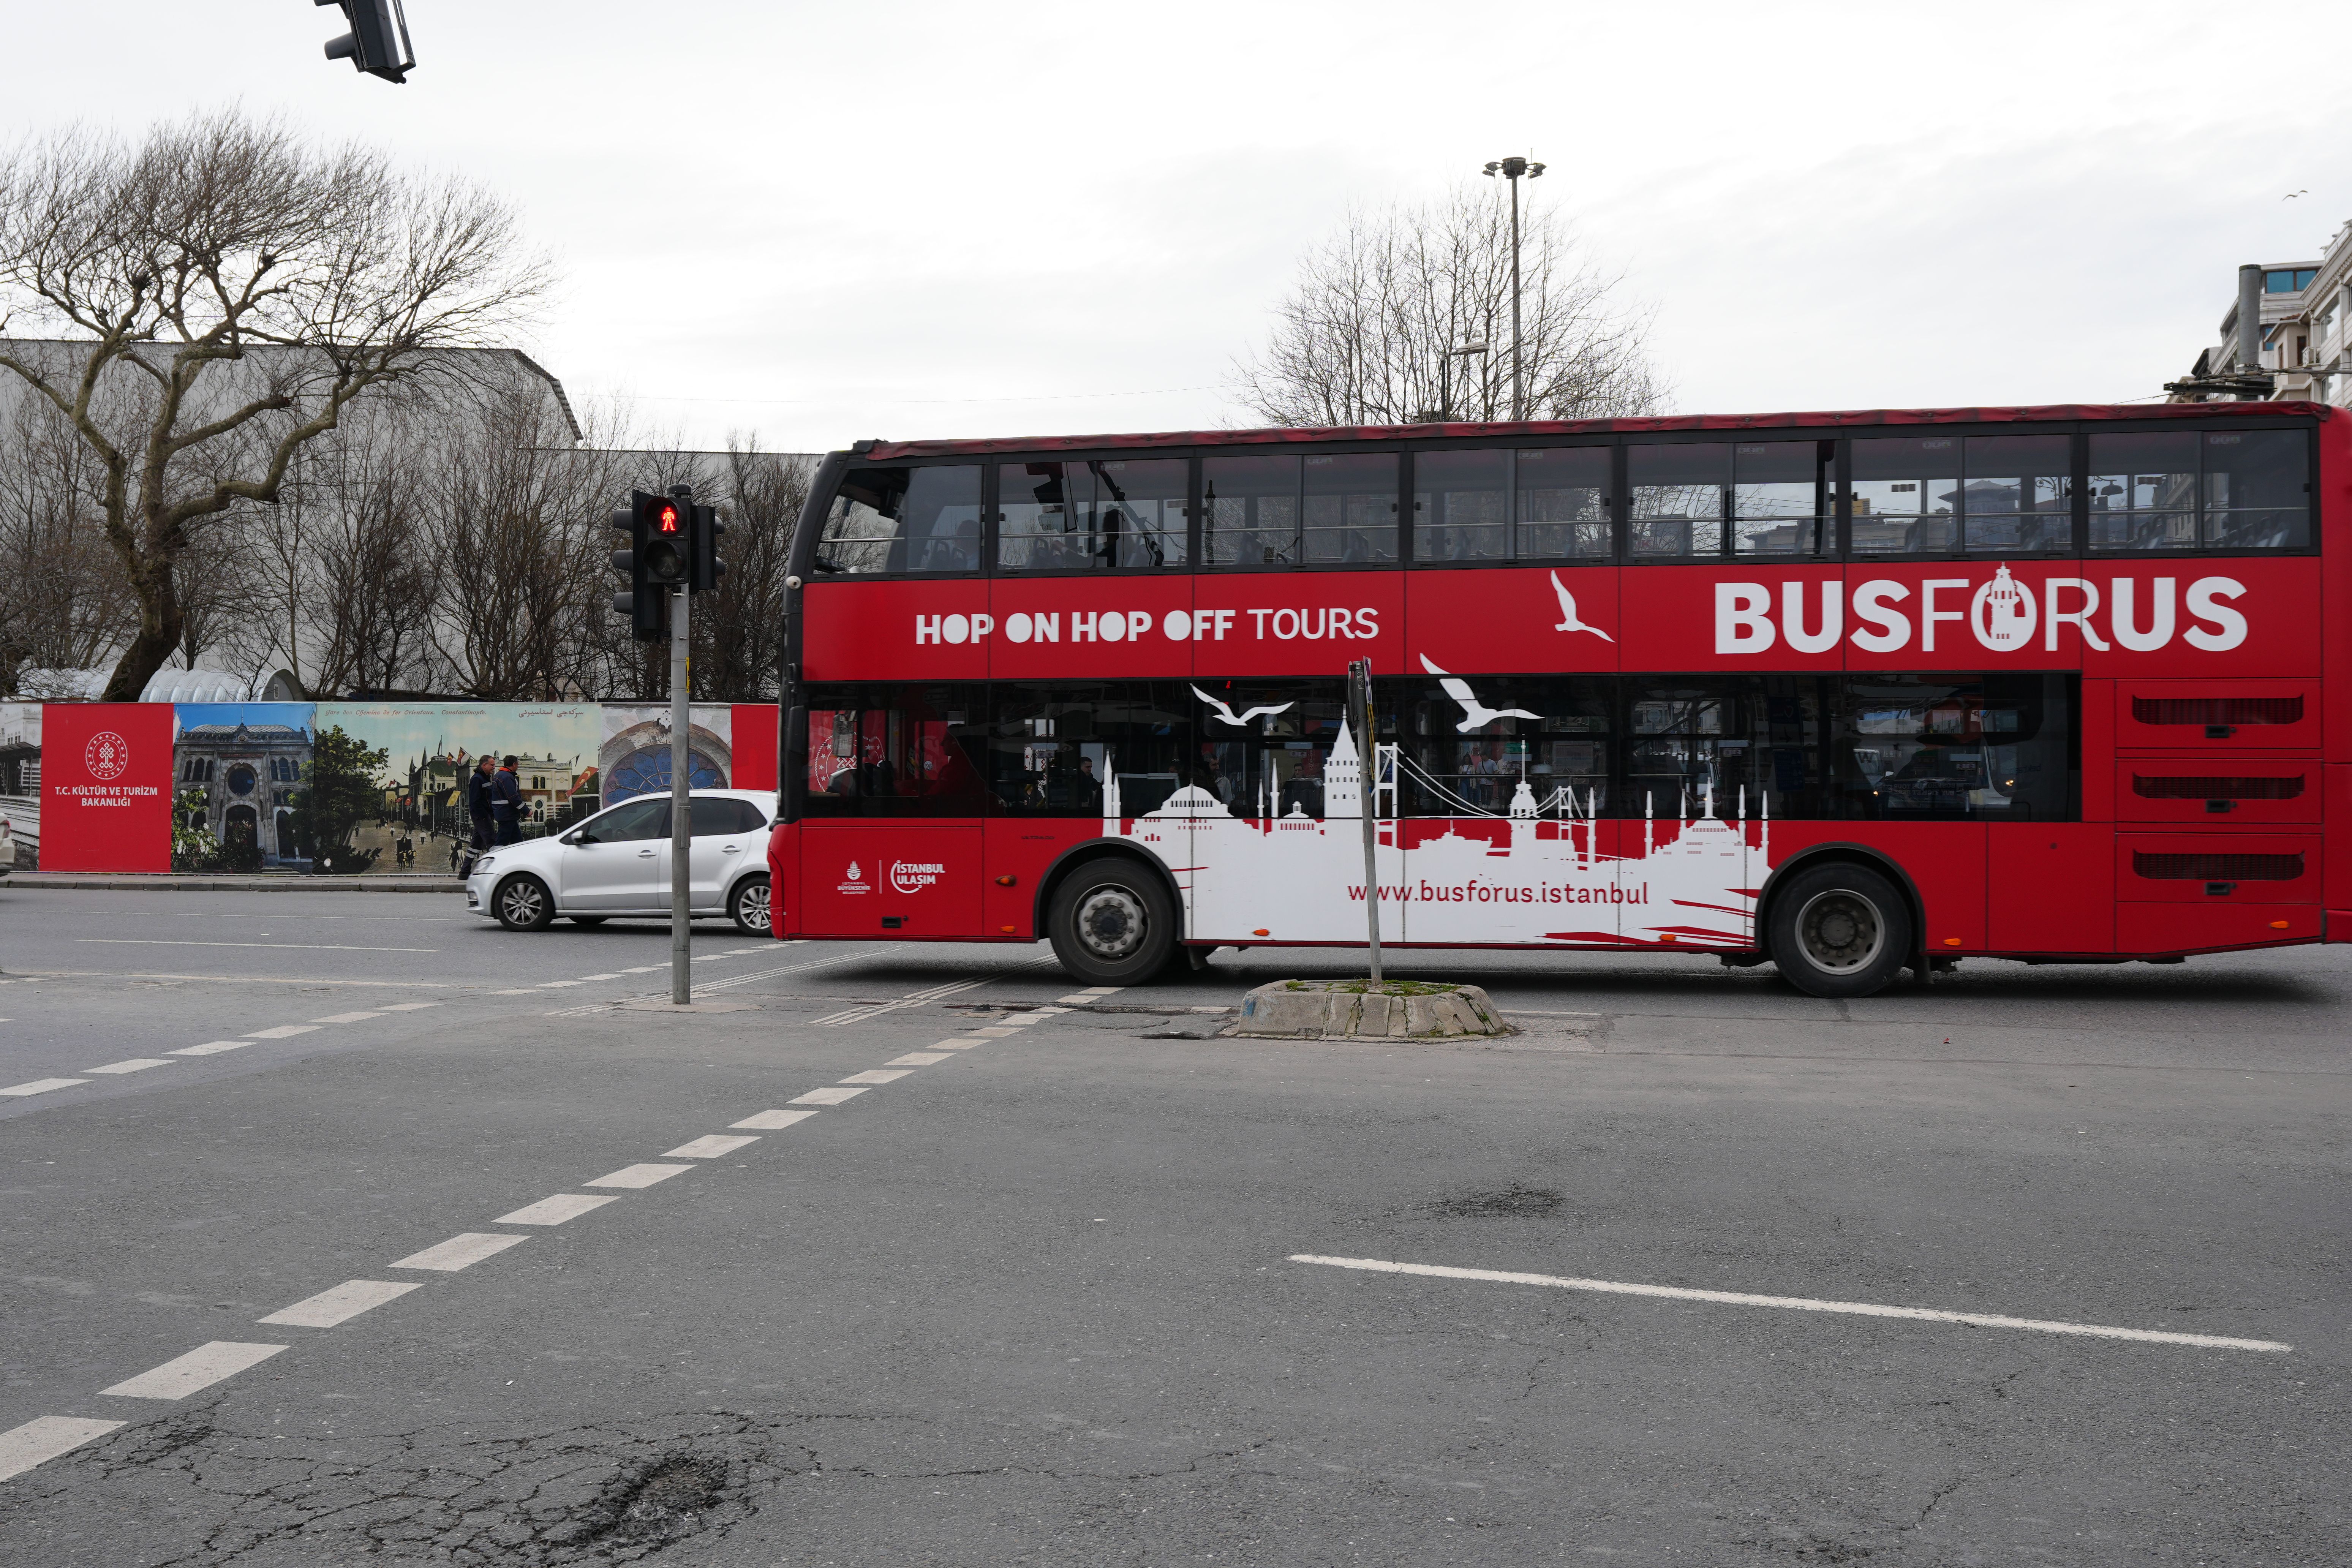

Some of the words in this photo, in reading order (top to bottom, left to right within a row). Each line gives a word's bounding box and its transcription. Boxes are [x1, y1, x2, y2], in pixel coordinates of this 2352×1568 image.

[1715, 576, 2248, 653] BUSFORUS
[916, 613, 994, 645] HOP
[1005, 612, 1059, 643] ON
[1072, 611, 1152, 642] HOP
[1163, 609, 1236, 641] OFF
[1247, 607, 1379, 640] TOURS
[55, 786, 70, 795] T.C.
[72, 785, 107, 795] KÜLTÜR
[109, 787, 120, 795] VE
[123, 785, 158, 795] TURİZM
[81, 796, 130, 806] BAKANLIĞI
[896, 860, 946, 873] İSTANBUL
[896, 875, 936, 887] ULAŞIM
[1347, 879, 1648, 904] www.busforus.istanbul
